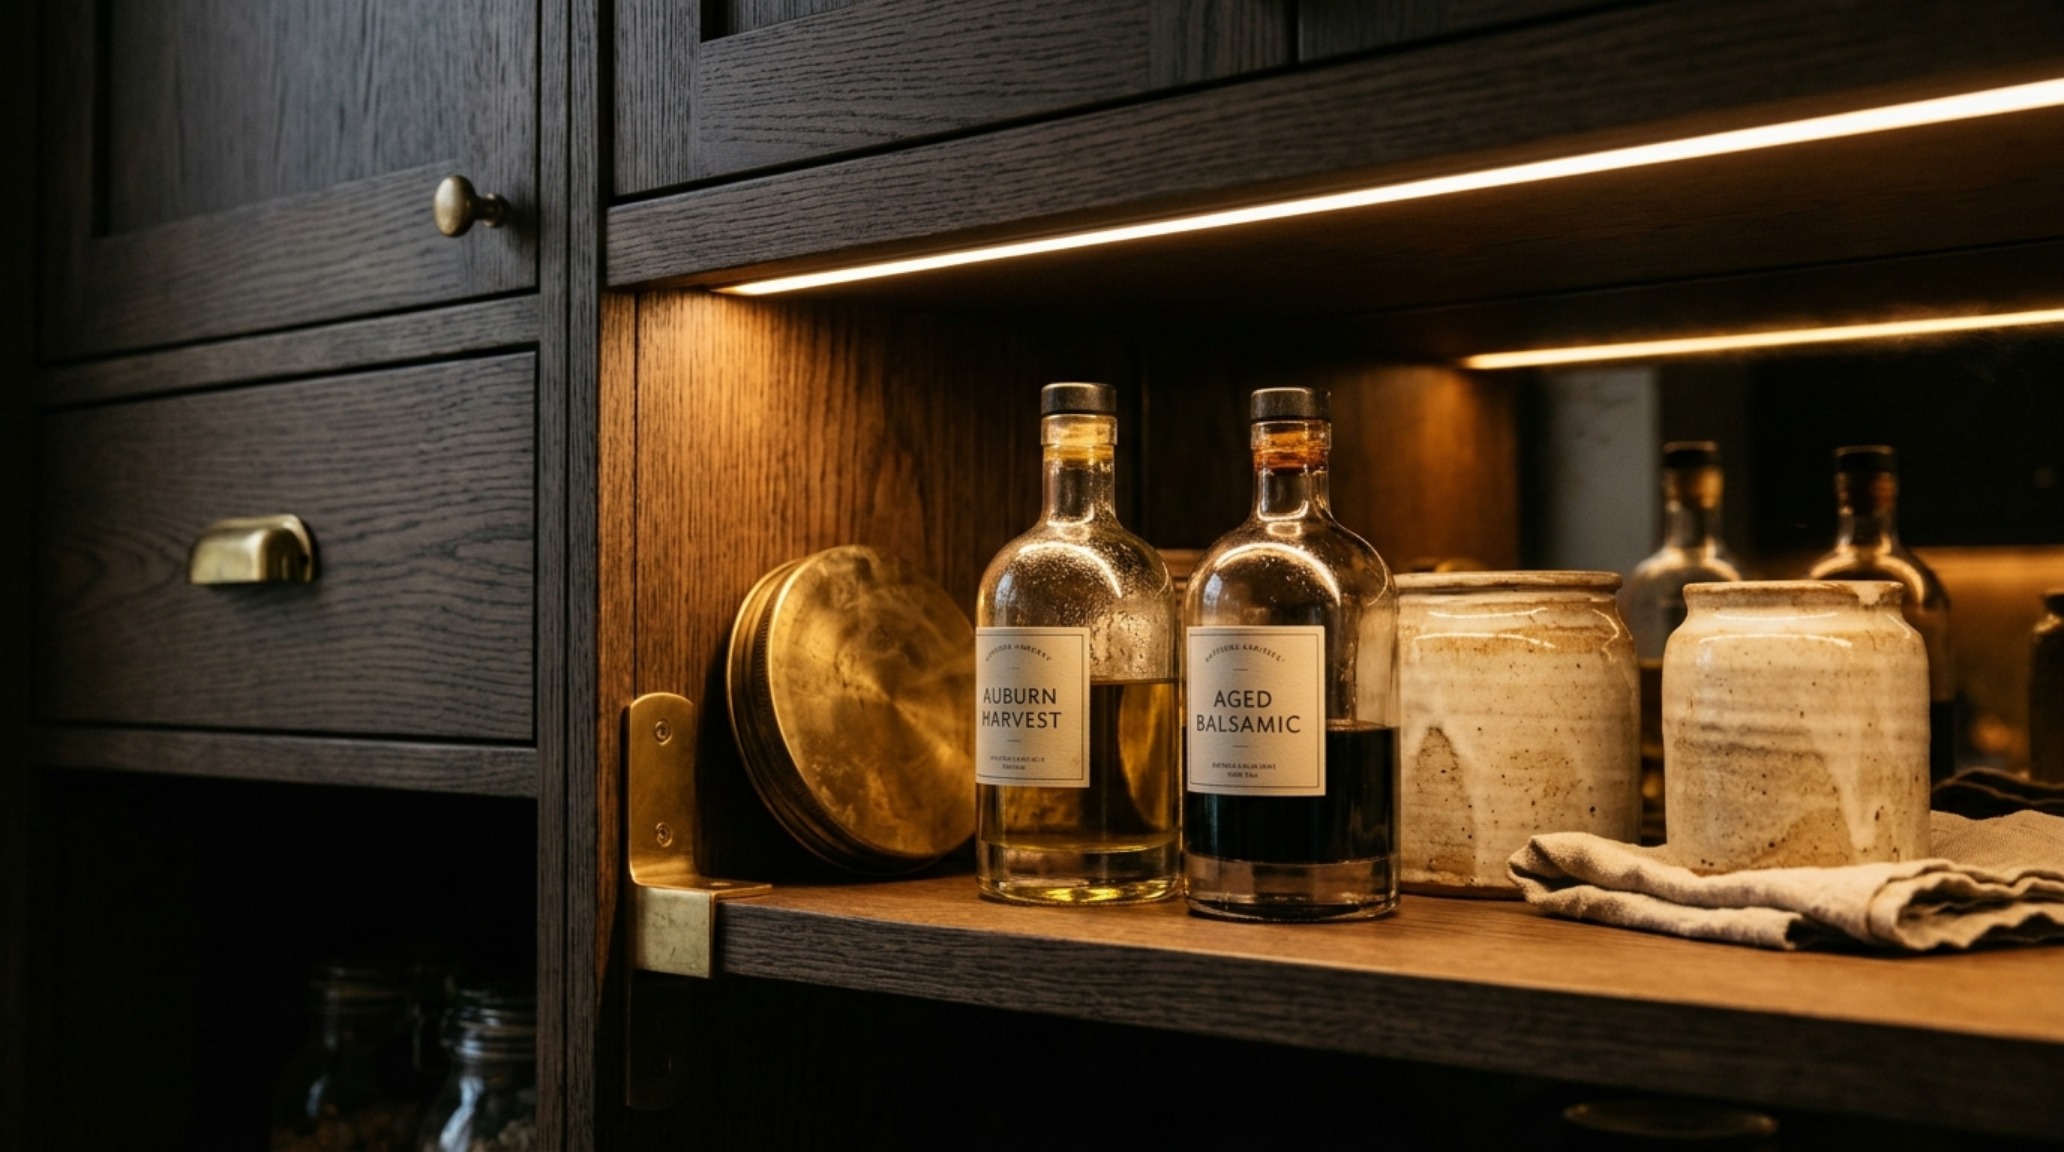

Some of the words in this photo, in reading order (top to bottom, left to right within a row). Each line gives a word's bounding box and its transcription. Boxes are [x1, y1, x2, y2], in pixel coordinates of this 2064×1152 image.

[983, 688, 1056, 705] AUBURN
[1213, 690, 1272, 708] AGED
[982, 711, 1062, 729] HARVEST
[1196, 714, 1301, 734] BALSAMIC
